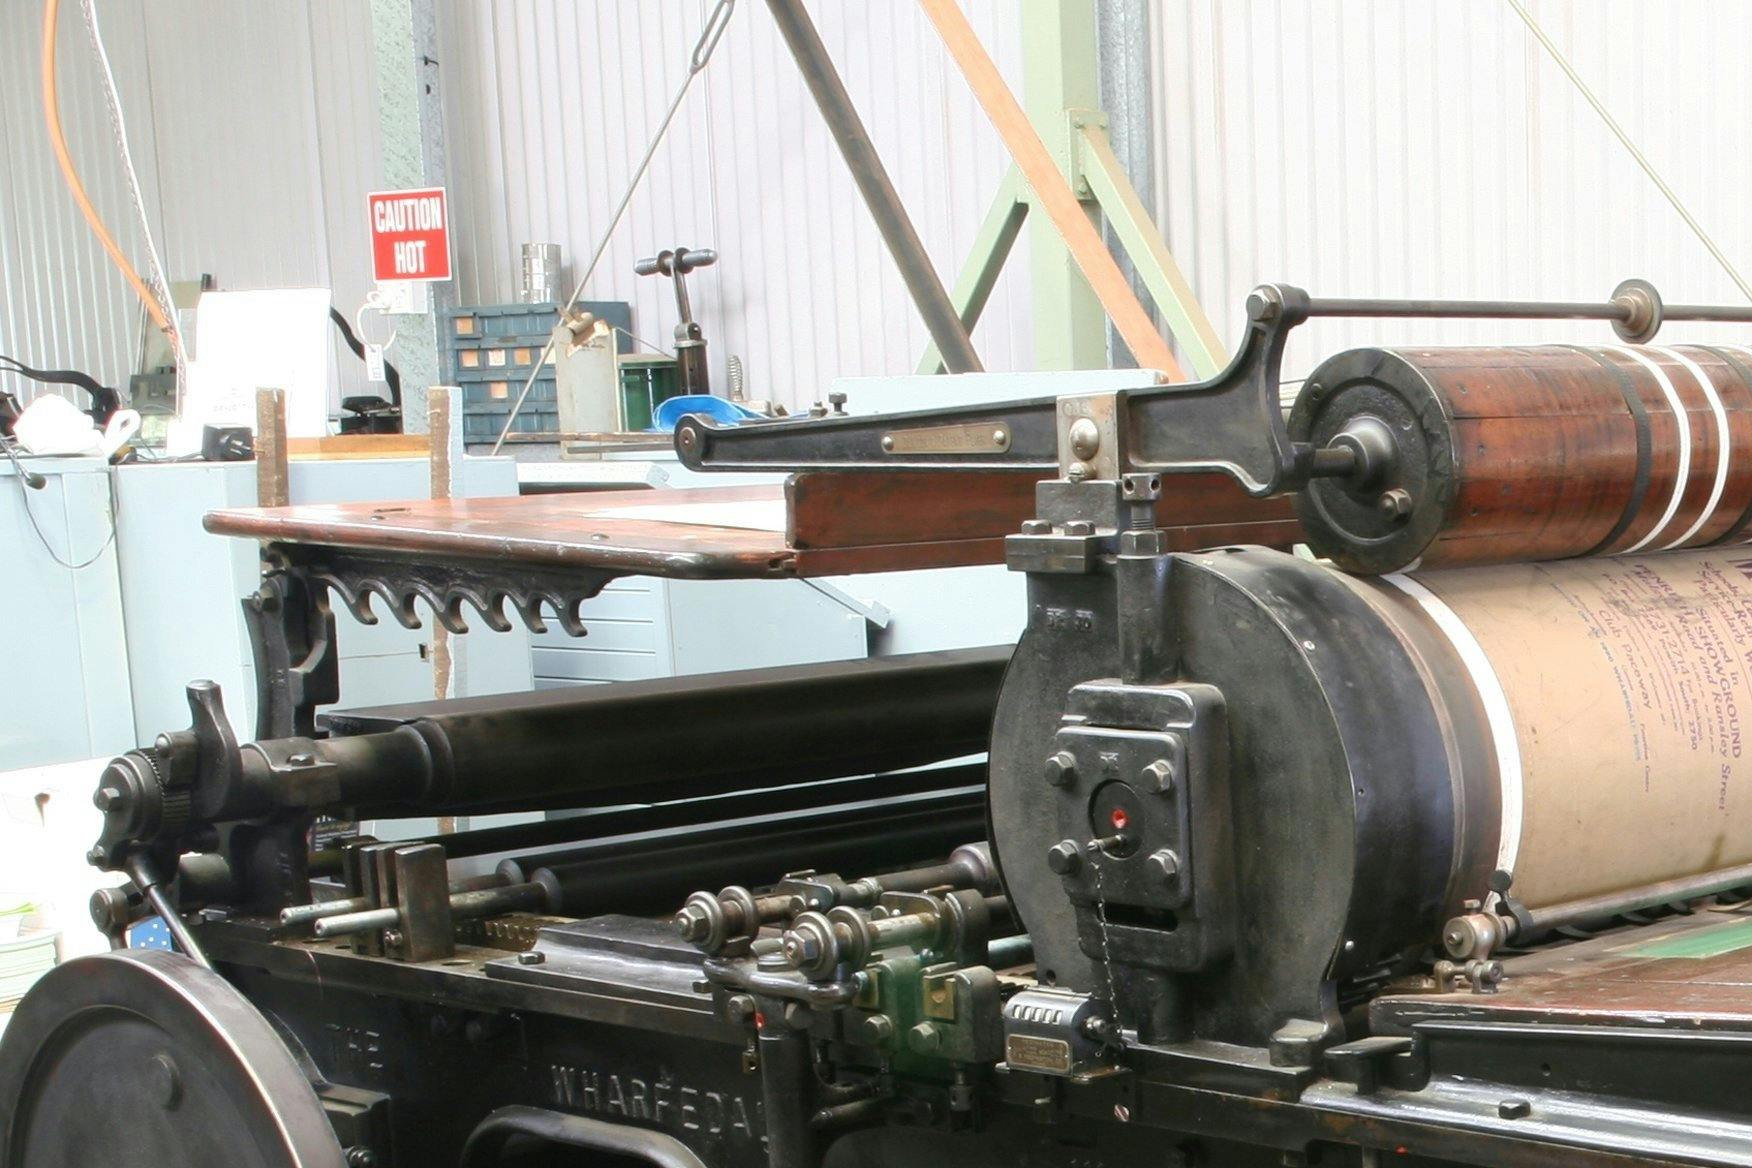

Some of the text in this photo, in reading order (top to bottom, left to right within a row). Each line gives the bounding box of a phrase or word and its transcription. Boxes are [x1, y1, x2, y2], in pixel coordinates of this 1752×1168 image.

[374, 197, 442, 233] CAUTION
[394, 240, 426, 274] HOT
[1599, 609, 1621, 639] Club
[1696, 607, 1732, 664] Situated
[1700, 656, 1718, 685] and
[1694, 625, 1742, 759] SHOWGROUND
[1712, 690, 1729, 758] Ransley
[1719, 763, 1731, 811] Street
